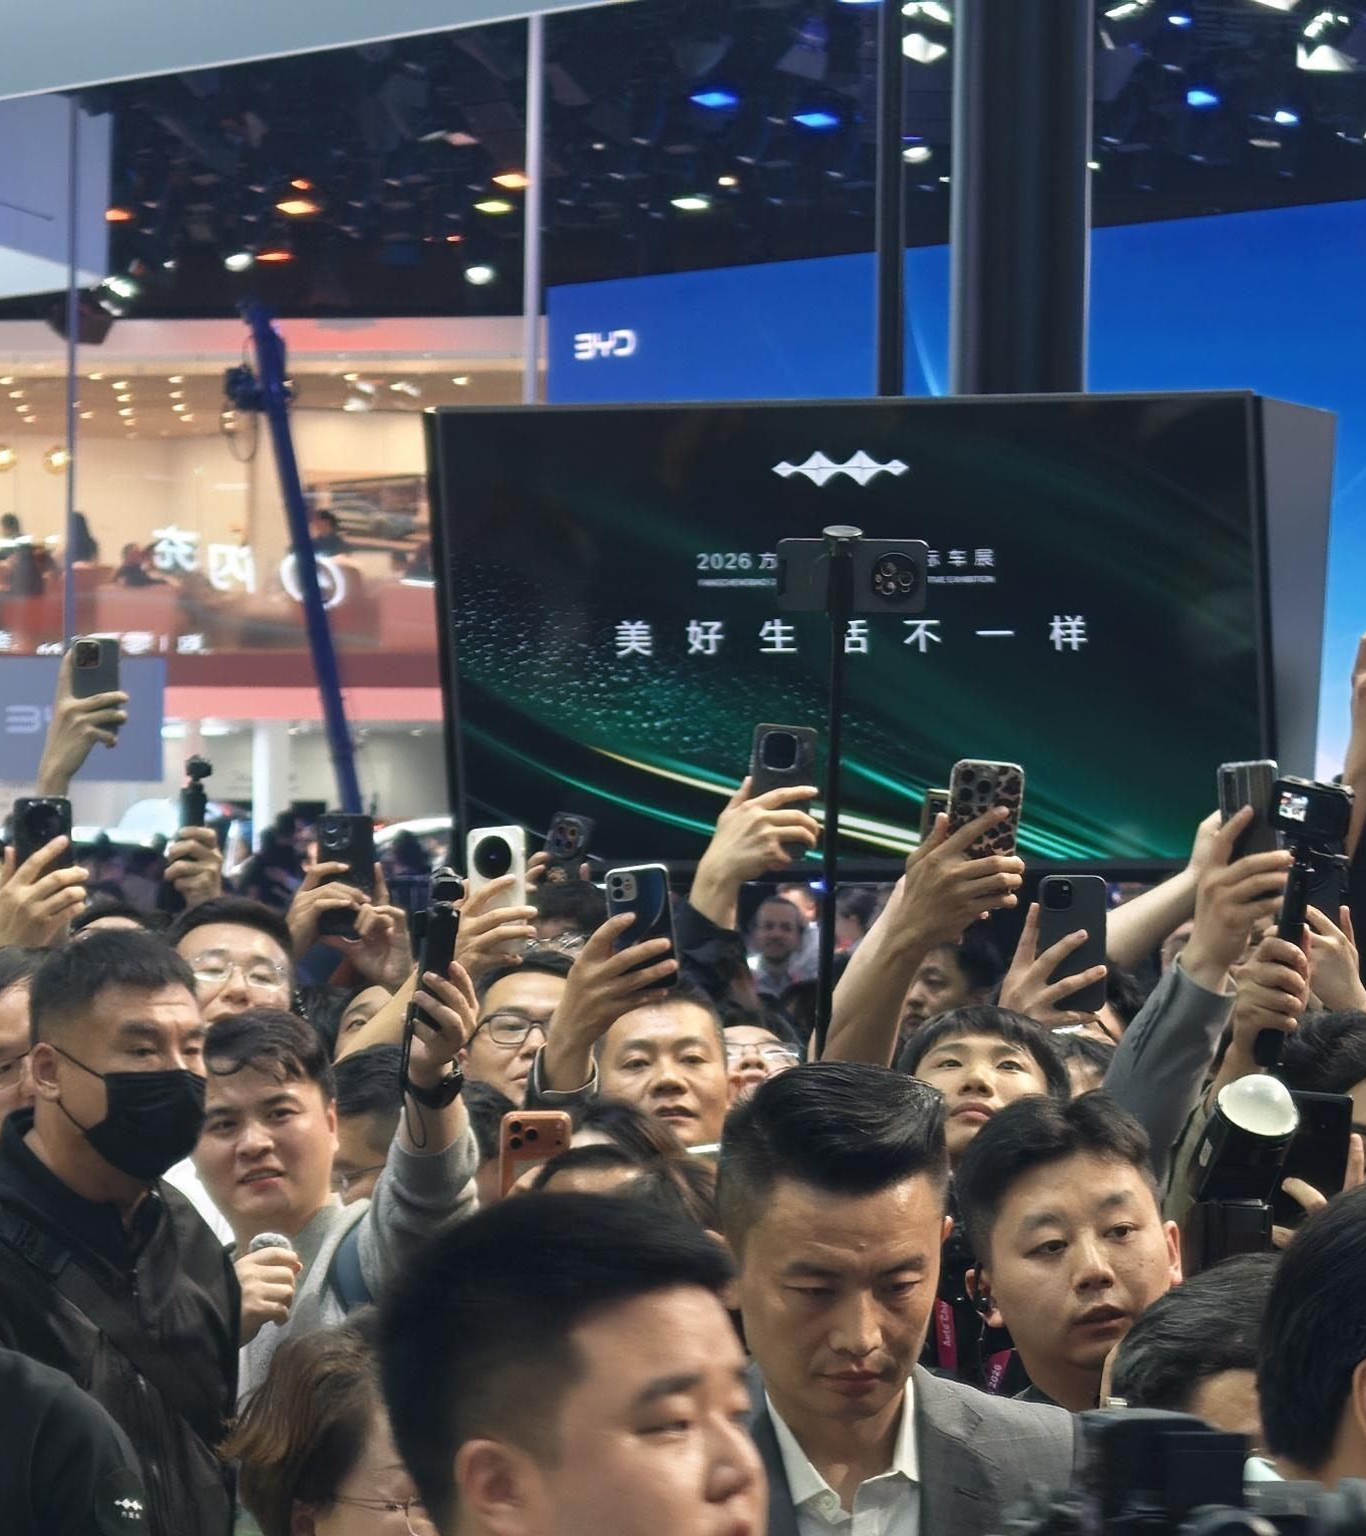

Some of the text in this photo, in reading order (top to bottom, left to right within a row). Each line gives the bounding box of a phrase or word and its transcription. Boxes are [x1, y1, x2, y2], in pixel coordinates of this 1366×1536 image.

[574, 329, 636, 360] BYD
[615, 615, 1088, 658] 美好生活不一样
